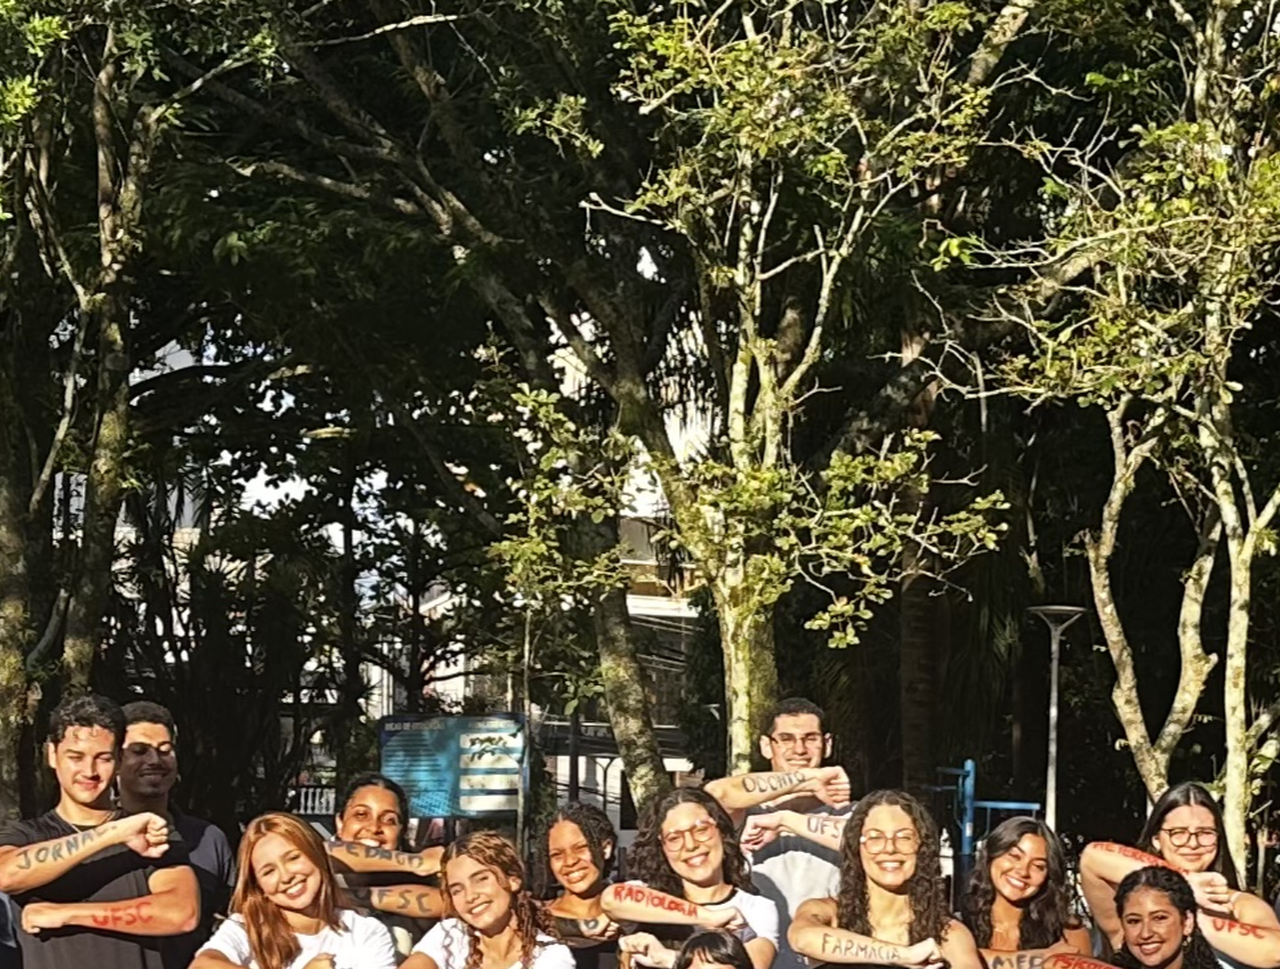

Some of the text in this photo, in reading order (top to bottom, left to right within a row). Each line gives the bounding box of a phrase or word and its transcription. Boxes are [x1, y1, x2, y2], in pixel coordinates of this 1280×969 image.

[741, 770, 805, 793] ODONTO
[806, 815, 841, 839] UFS
[91, 901, 153, 927] UFSC
[1211, 918, 1266, 939] UFSC
